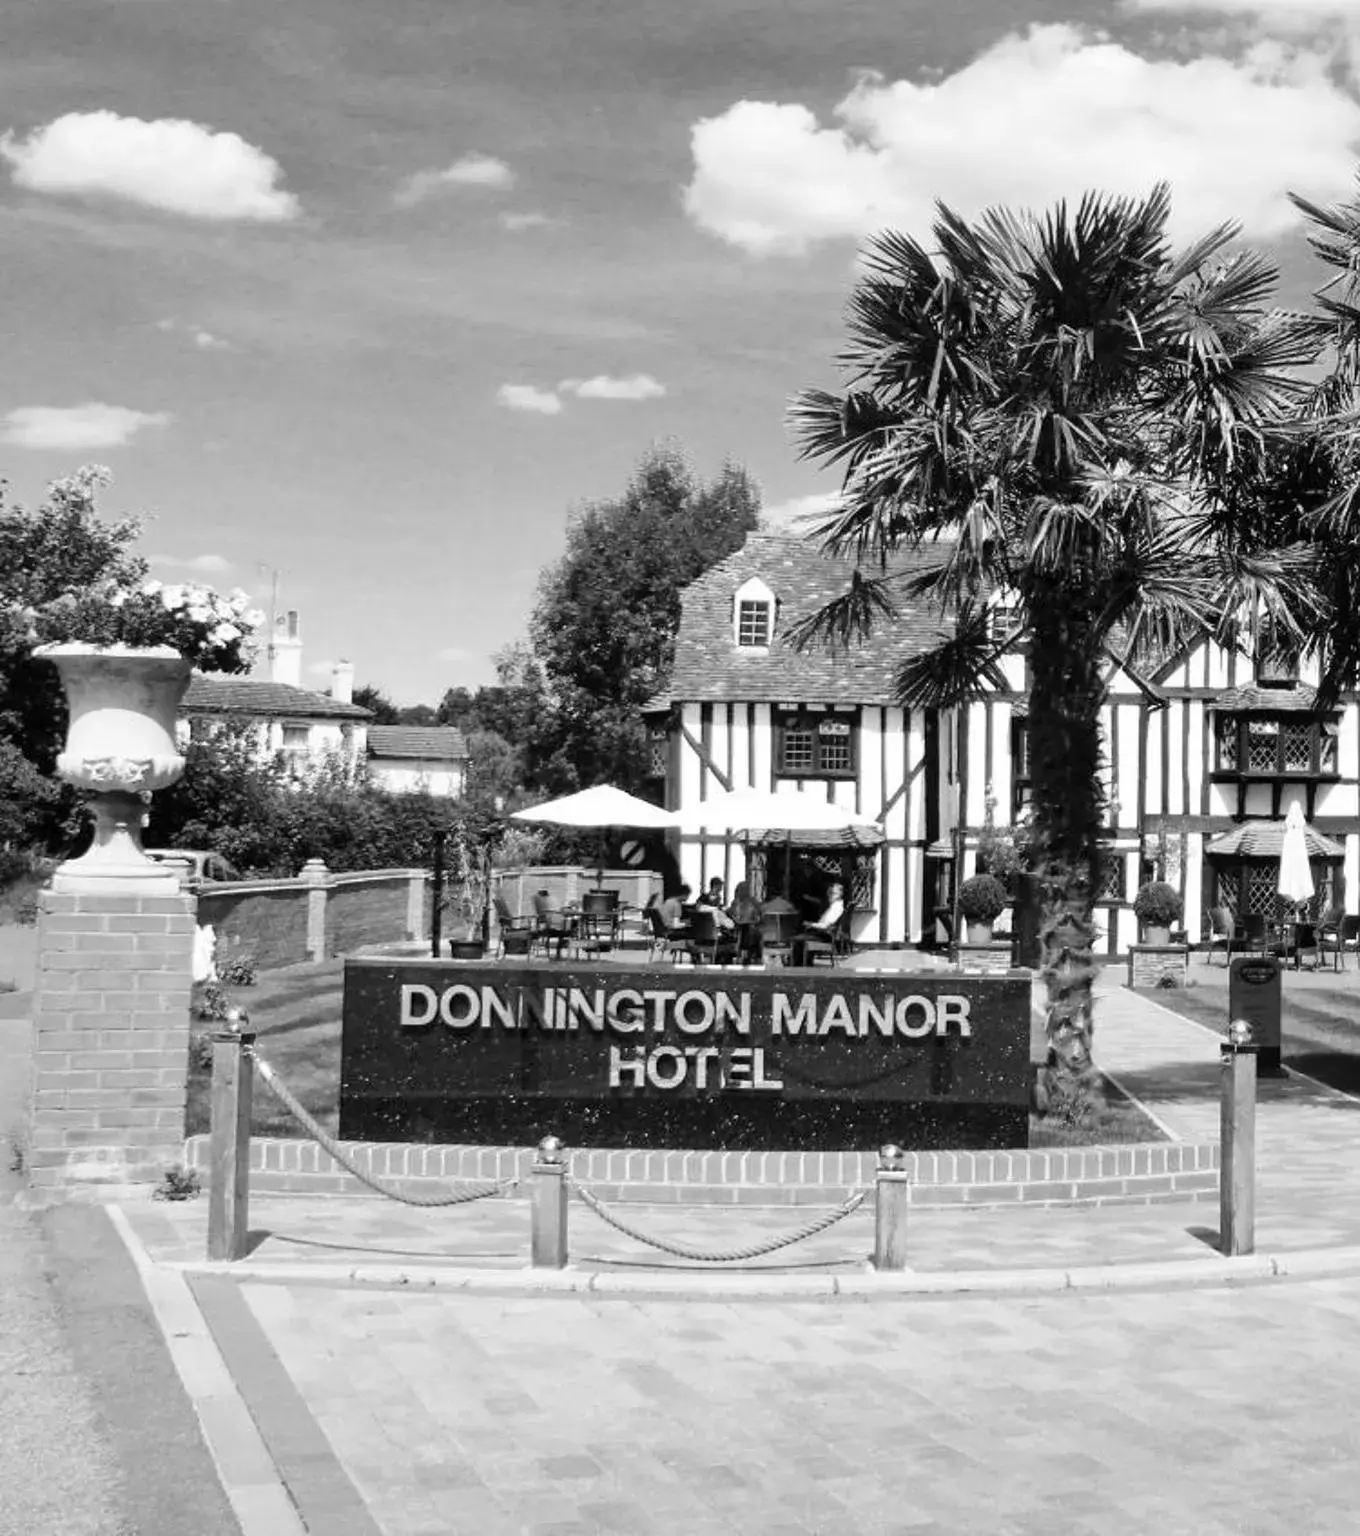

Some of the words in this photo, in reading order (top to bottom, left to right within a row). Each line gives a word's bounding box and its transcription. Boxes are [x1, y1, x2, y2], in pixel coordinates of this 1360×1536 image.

[400, 984, 750, 1033] DONNINGTON
[772, 993, 972, 1037] MANOR
[609, 1045, 784, 1090] HOTEL
